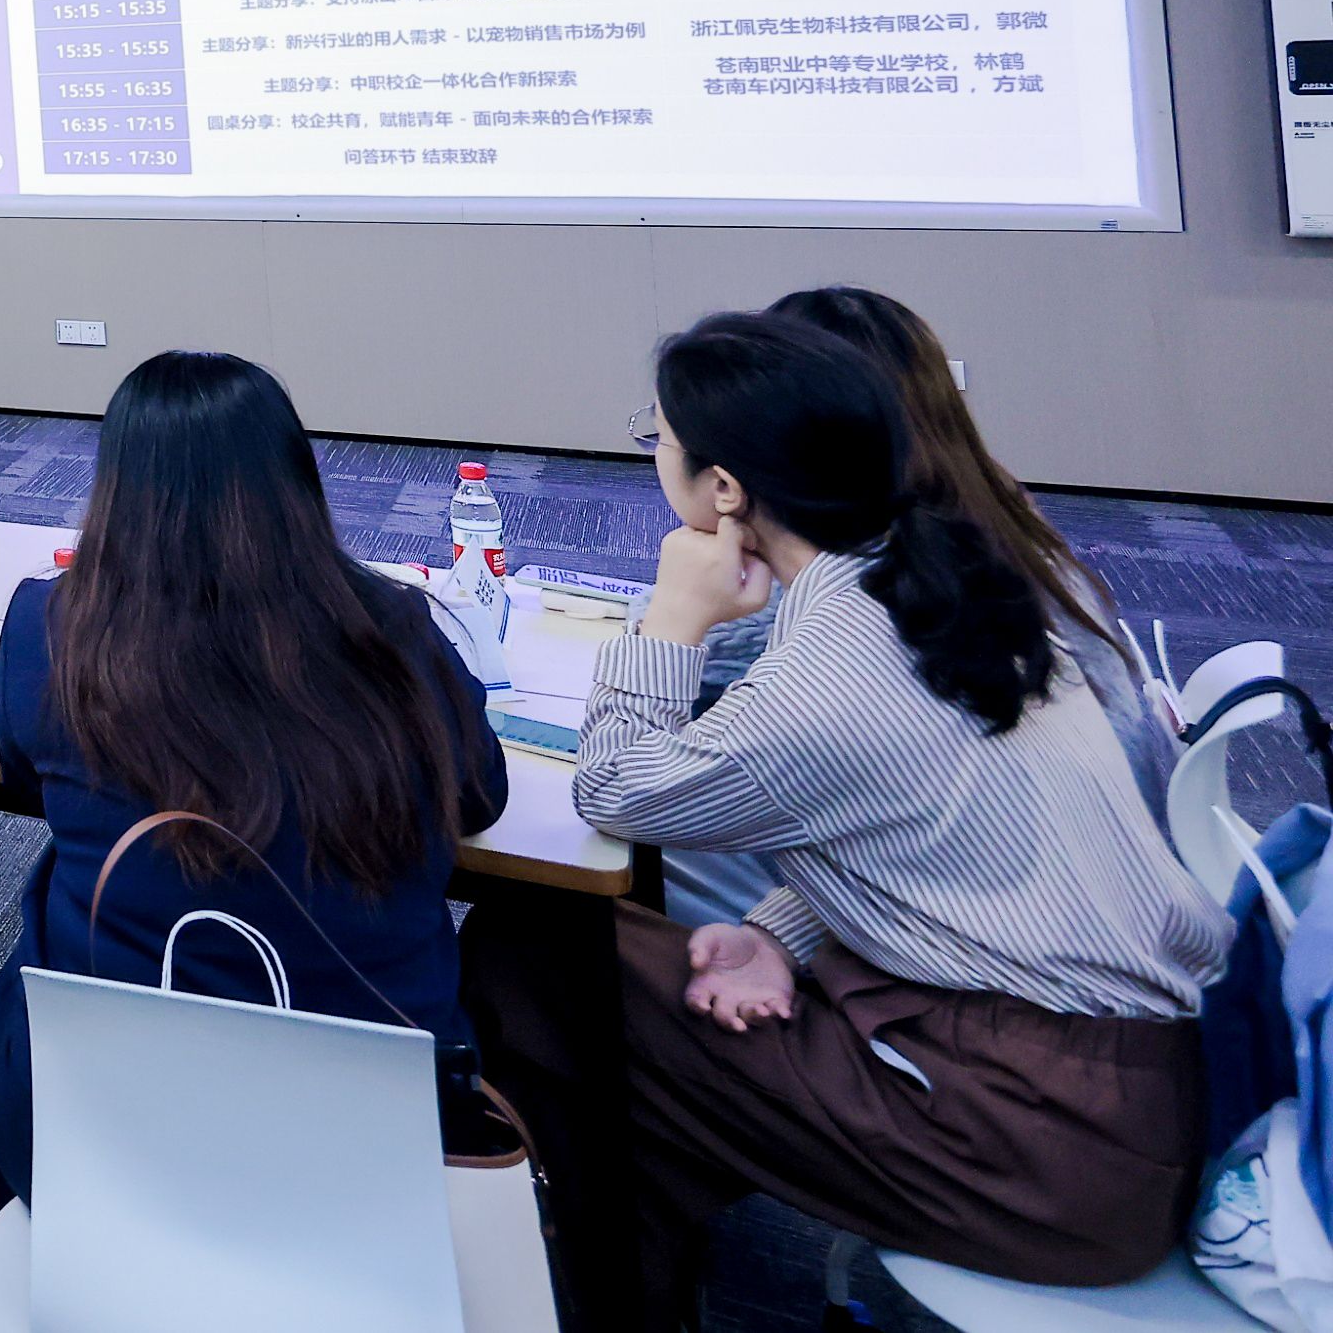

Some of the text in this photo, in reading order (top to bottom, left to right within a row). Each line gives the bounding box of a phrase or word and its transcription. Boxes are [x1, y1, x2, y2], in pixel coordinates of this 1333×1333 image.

[53, 0, 167, 20] 15:15 15:35
[56, 40, 169, 59] 15:35 15:55
[58, 81, 173, 98] 15:55 16:35
[61, 116, 175, 133] 16:35 17:15
[63, 150, 178, 166] 17:15 17:30
